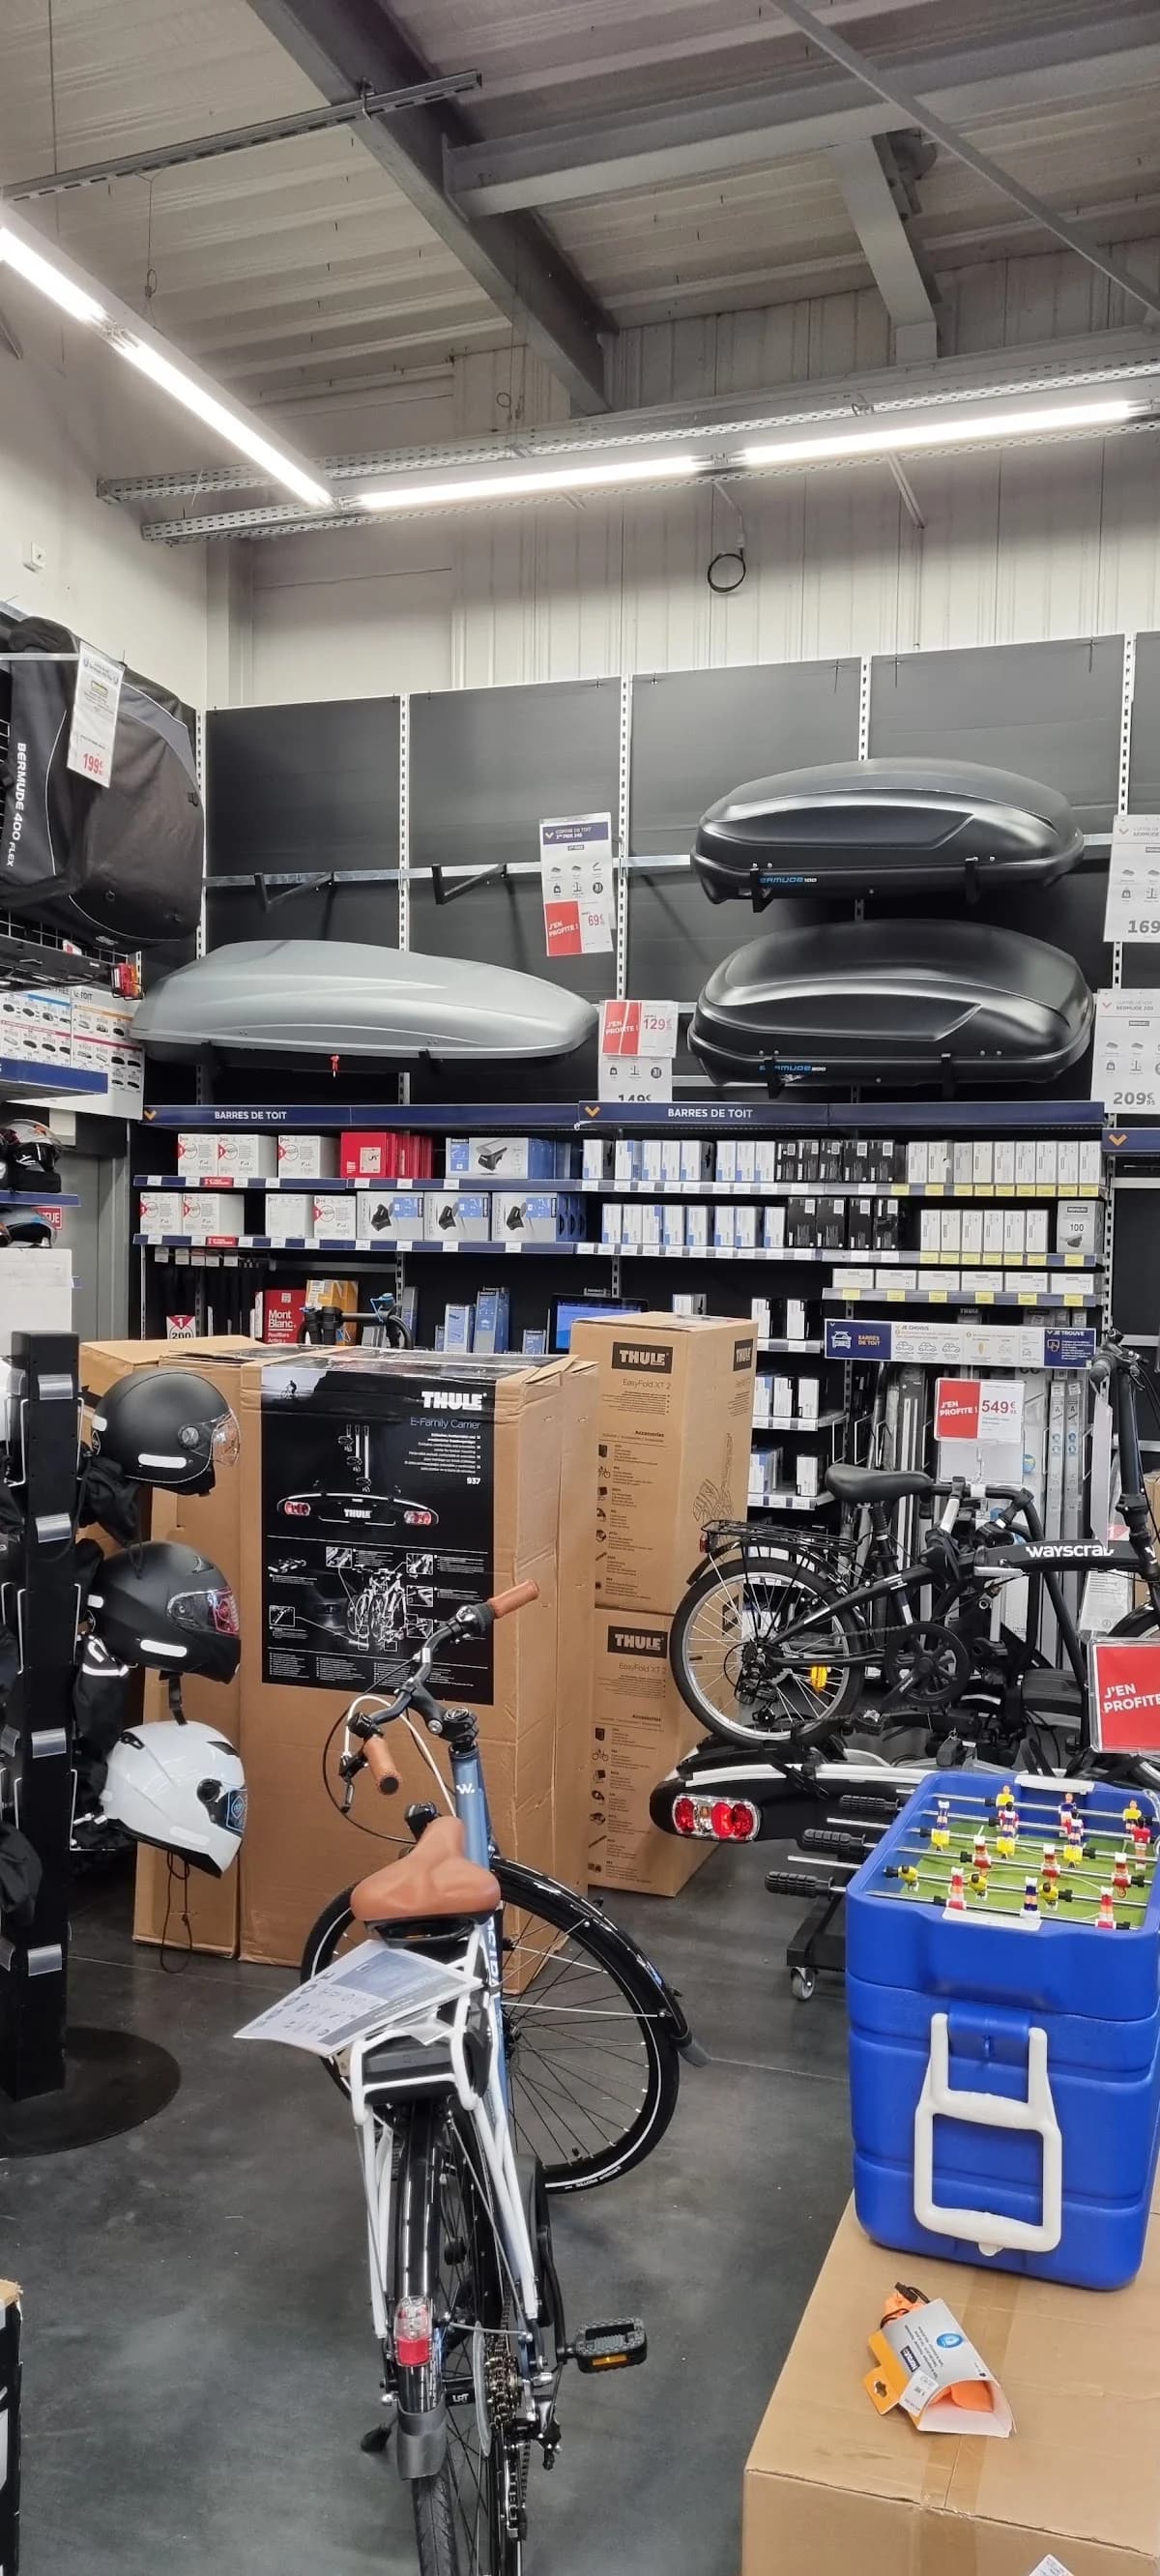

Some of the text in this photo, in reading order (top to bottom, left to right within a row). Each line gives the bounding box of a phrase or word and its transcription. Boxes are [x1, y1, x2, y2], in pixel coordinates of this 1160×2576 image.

[7, 743, 26, 866] BERMUDE 400 FLEX
[548, 924, 574, 937] PROFITE
[215, 1111, 287, 1120] BARRES DE TOIT
[668, 1108, 753, 1118] BARRES DE TOIT
[1070, 1223, 1084, 1232] 100
[269, 1309, 292, 1319] Mont
[620, 1349, 666, 1366] THULE
[623, 1378, 653, 1389] EasyFold
[421, 1390, 483, 1411] THULE
[940, 1400, 959, 1409] J'EN
[939, 1406, 973, 1417] PROFITE
[410, 1417, 480, 1429] E-Family Carrier
[466, 1477, 481, 1485] 937
[615, 1633, 661, 1652] THULE
[1104, 1683, 1137, 1699] J'EN
[1103, 1693, 1160, 1713] PROFITE
